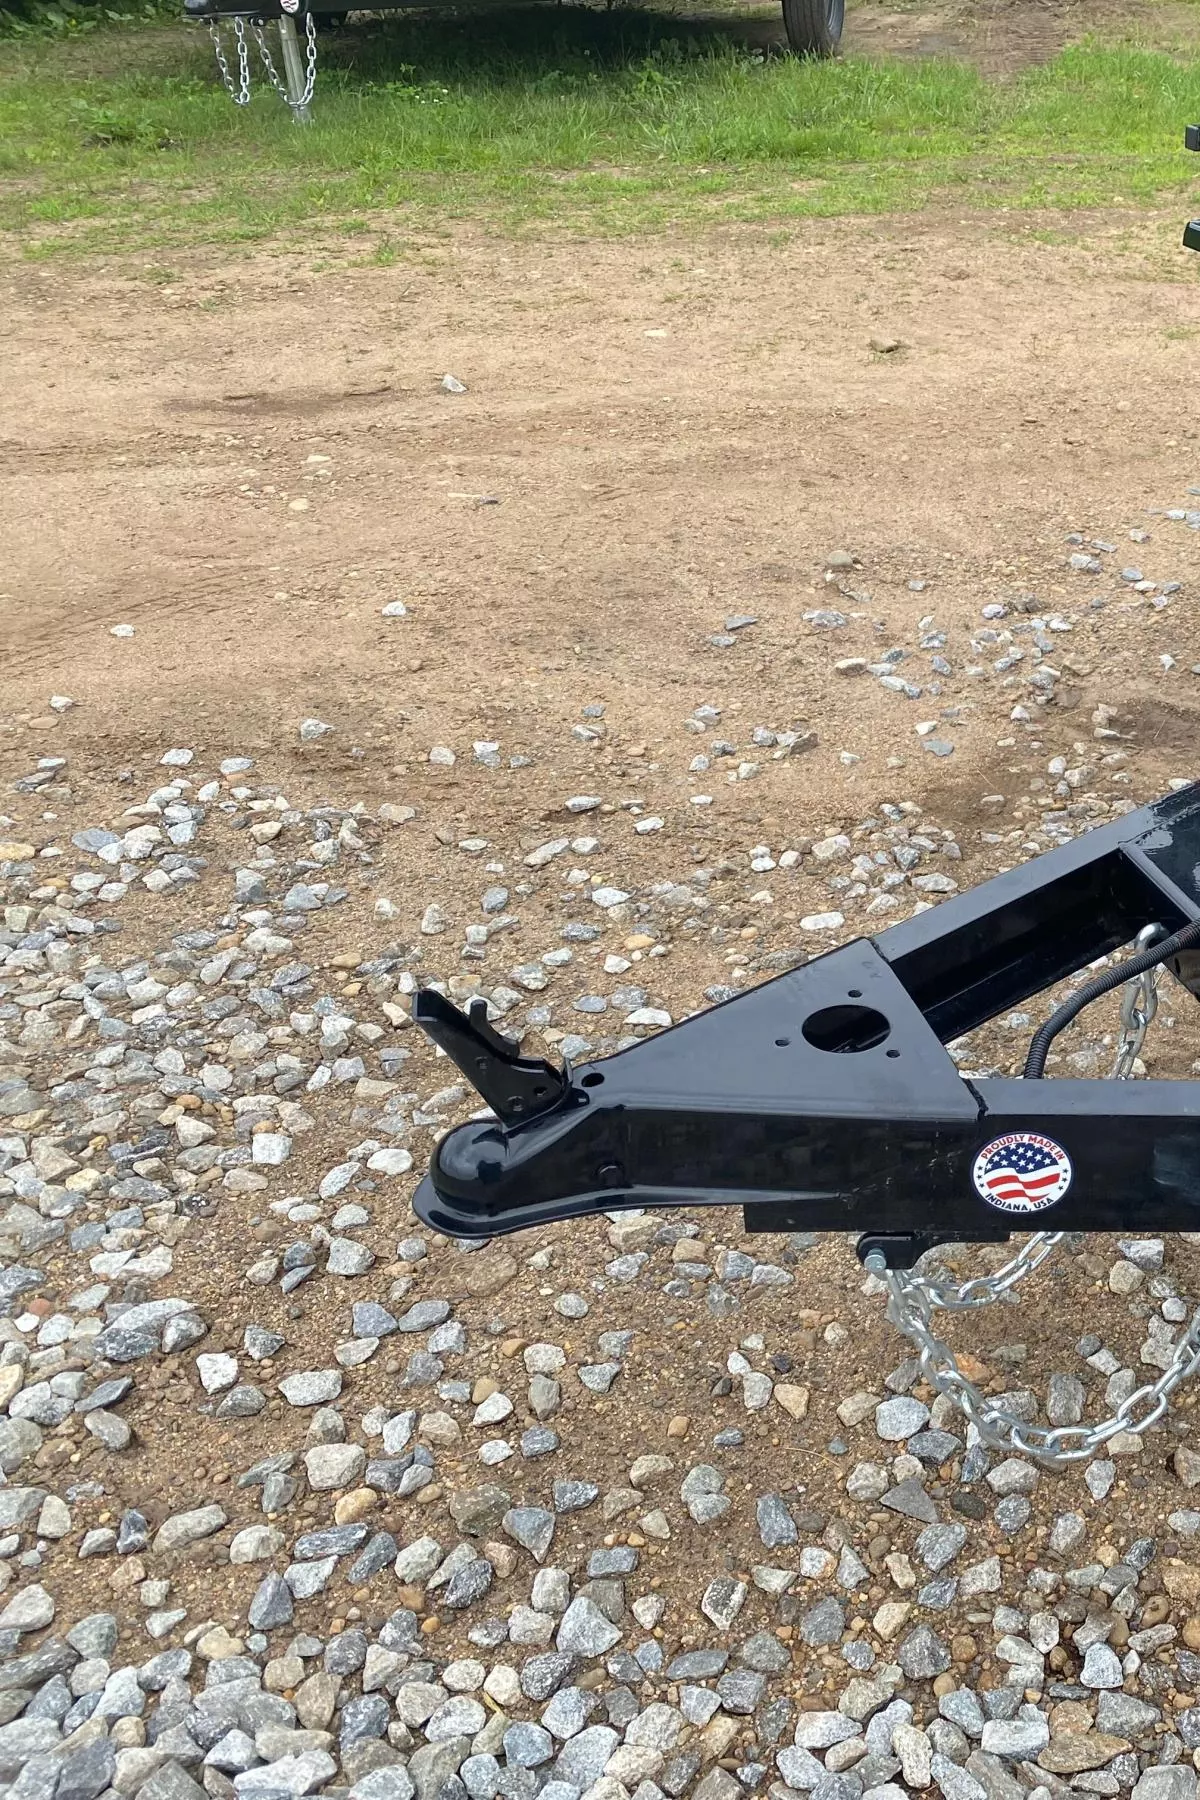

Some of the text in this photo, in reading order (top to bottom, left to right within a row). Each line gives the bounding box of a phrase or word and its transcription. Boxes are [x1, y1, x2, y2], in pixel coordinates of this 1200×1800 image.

[981, 1134, 1066, 1161] PROUDLY MADE IN
[985, 1192, 1055, 1212] INDIANA, USA
